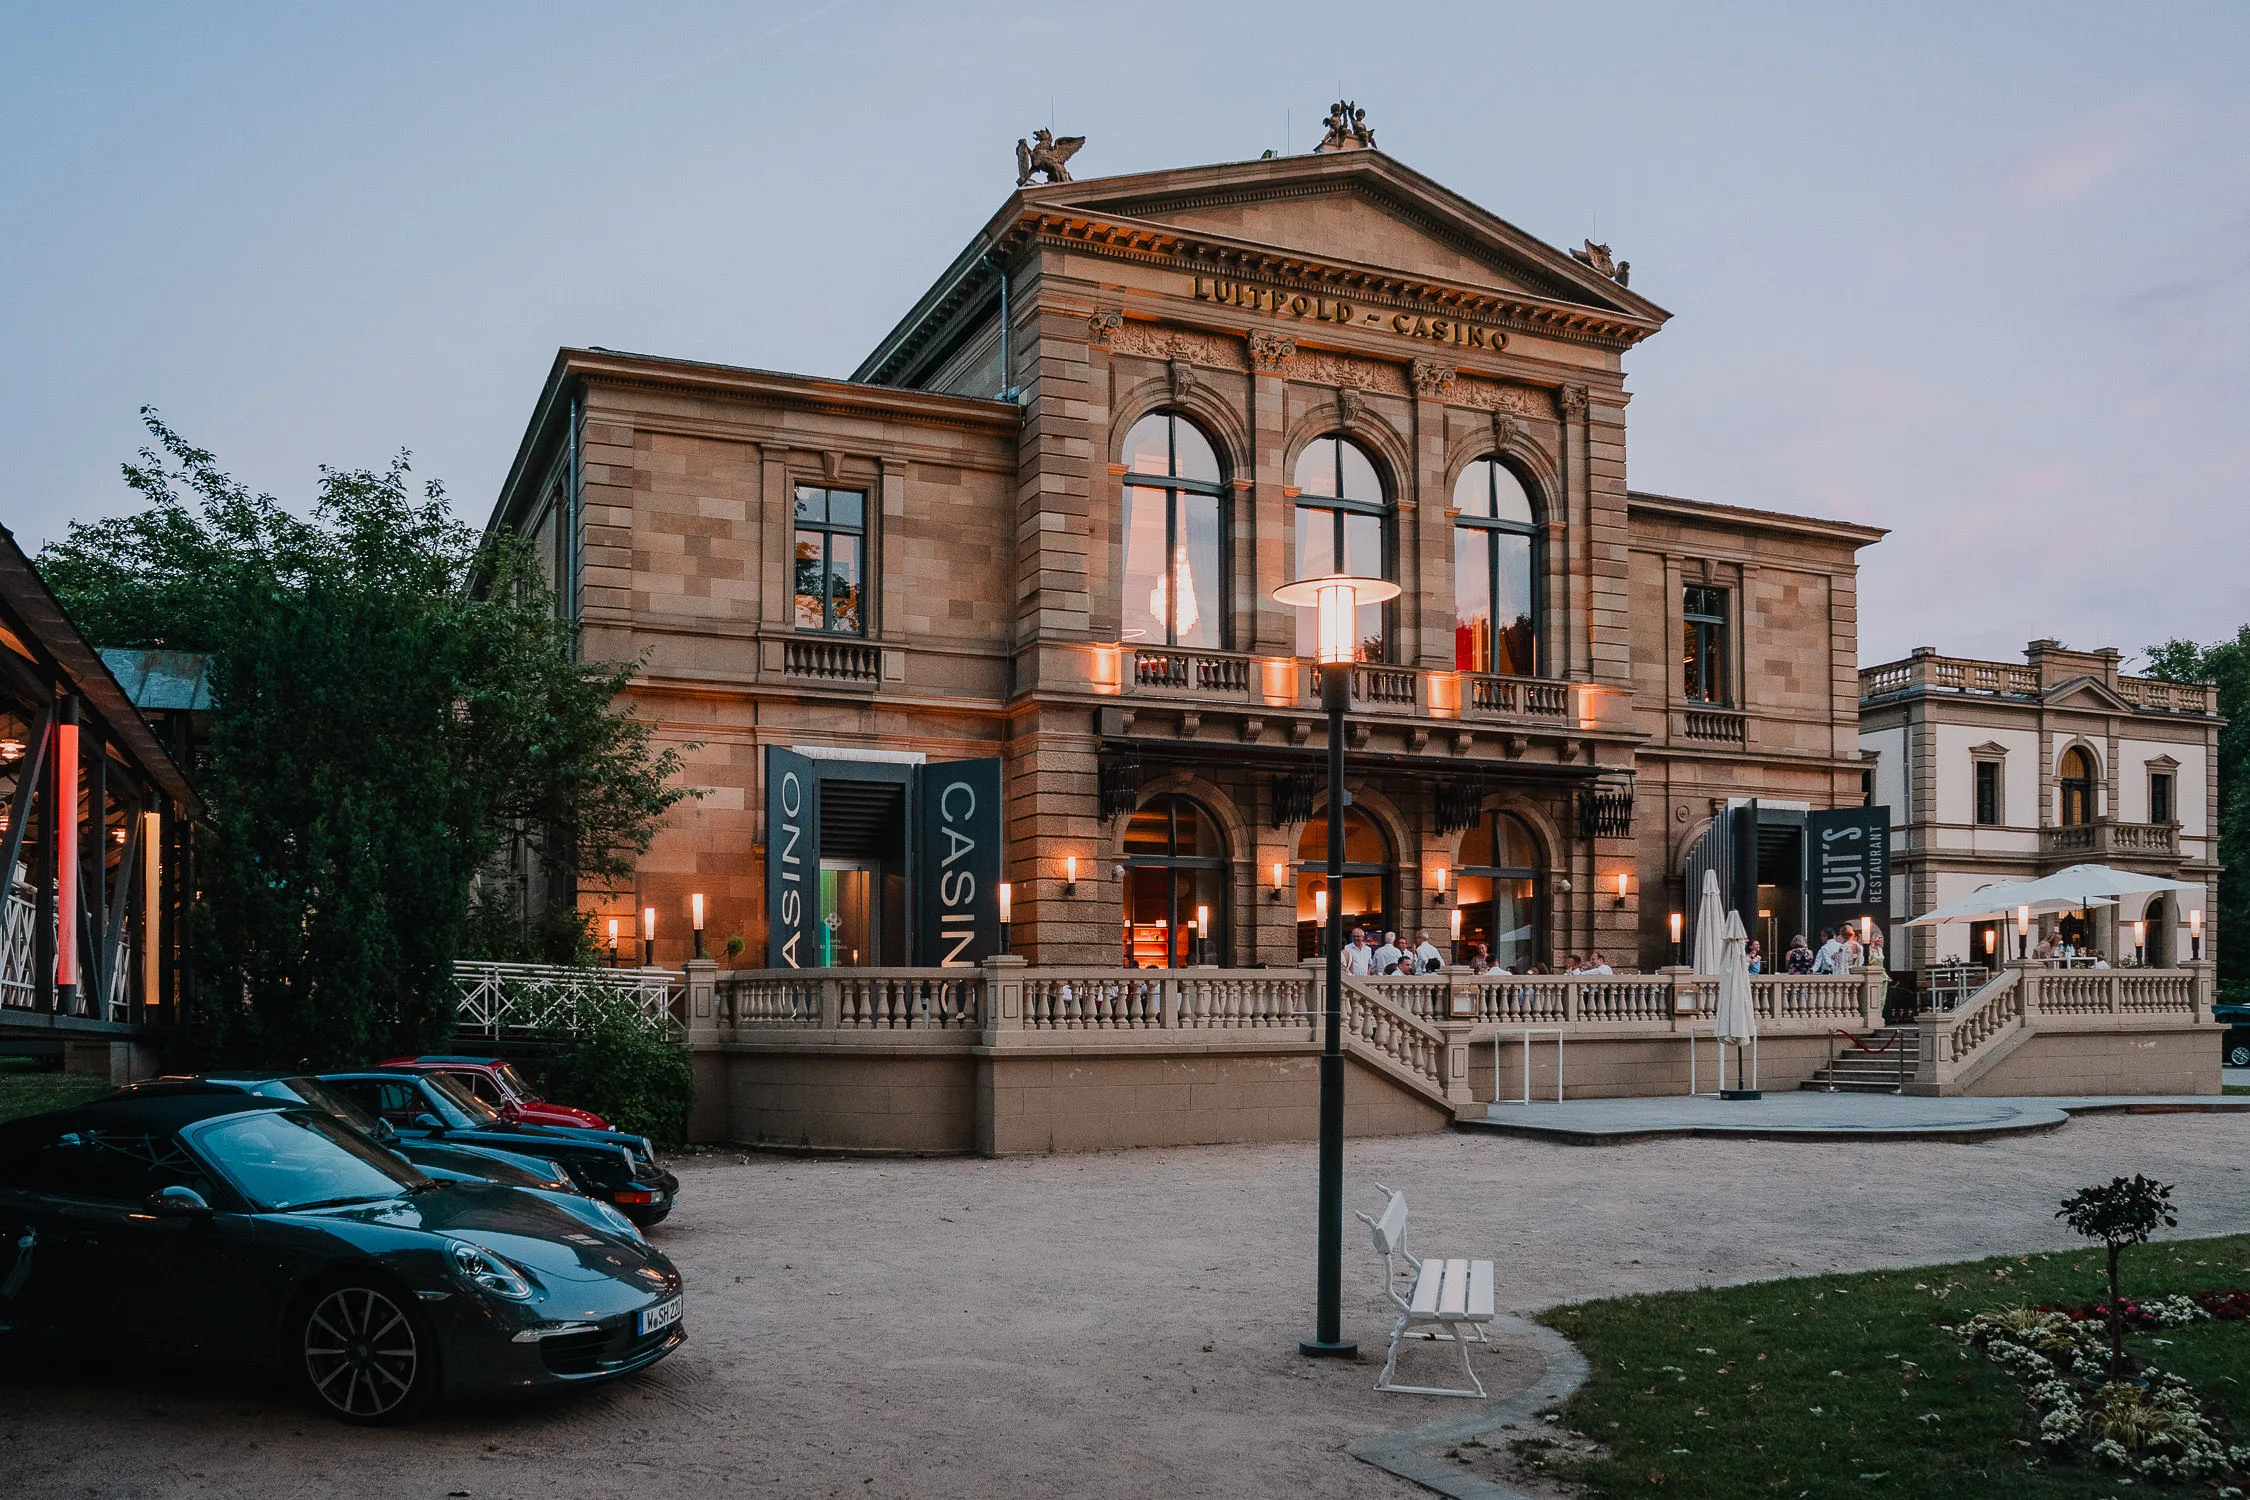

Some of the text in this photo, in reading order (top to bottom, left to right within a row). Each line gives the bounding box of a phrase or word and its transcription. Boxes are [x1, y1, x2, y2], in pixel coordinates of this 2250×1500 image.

[1192, 276, 1355, 323] LUITPOLD
[1392, 312, 1511, 351] CASINO
[782, 771, 801, 1017] ASINO
[941, 781, 975, 1015] CASIN
[1869, 826, 1882, 903] RESTAURANT
[658, 1305, 669, 1325] SH
